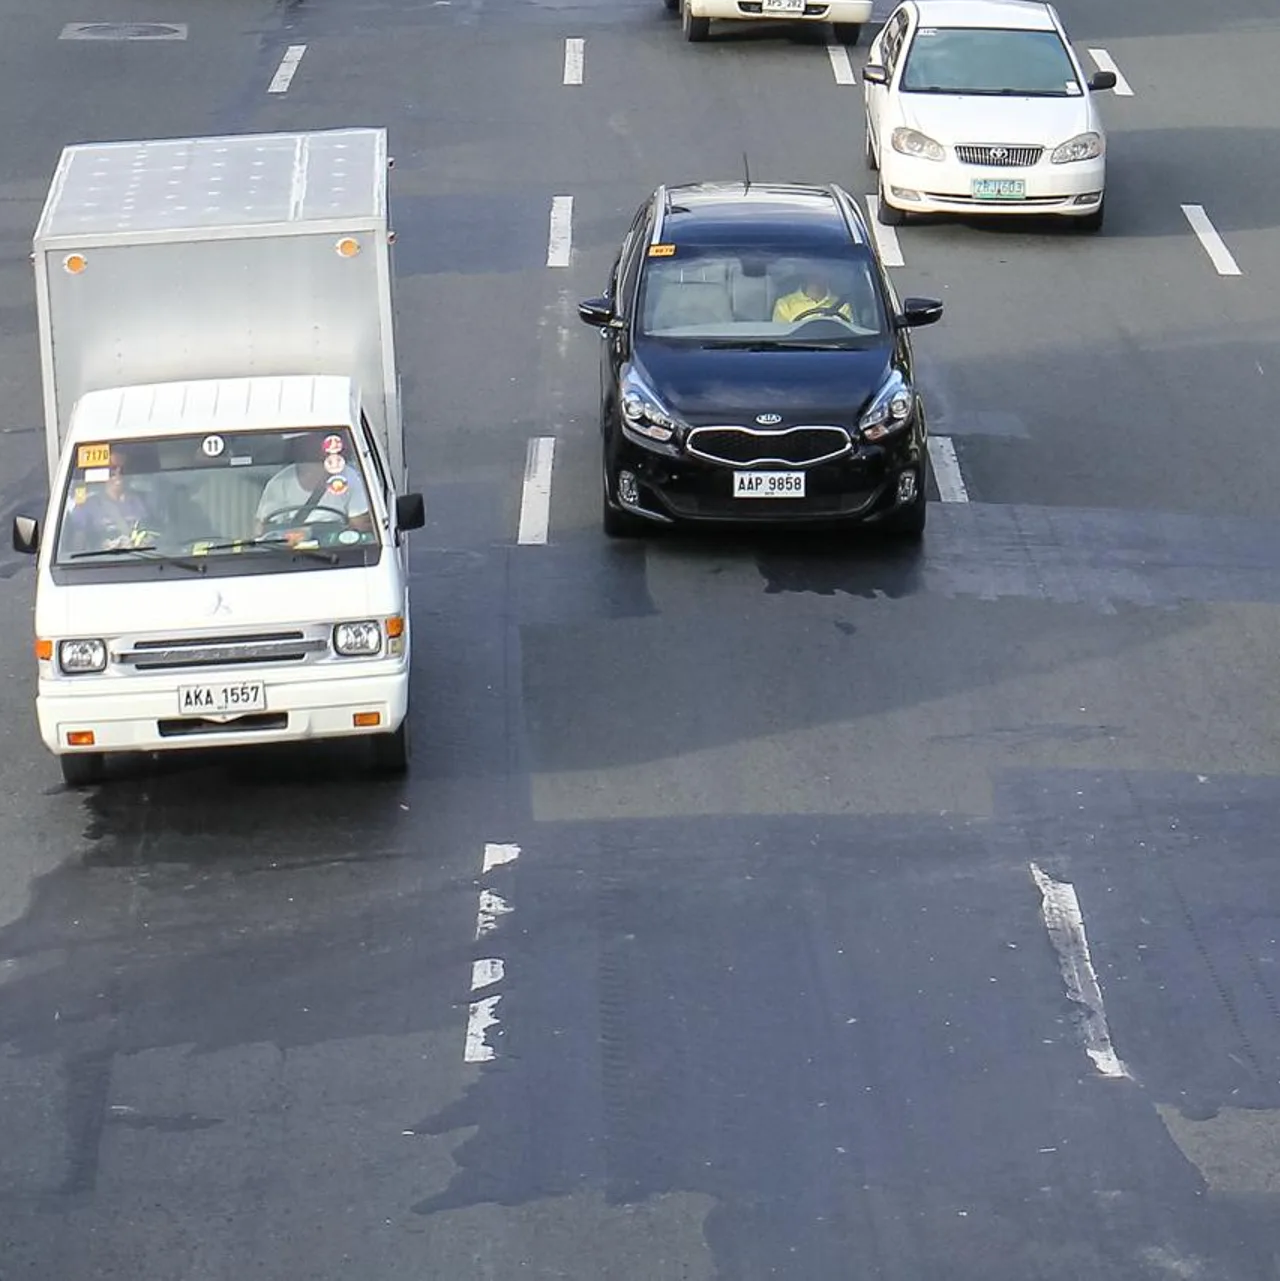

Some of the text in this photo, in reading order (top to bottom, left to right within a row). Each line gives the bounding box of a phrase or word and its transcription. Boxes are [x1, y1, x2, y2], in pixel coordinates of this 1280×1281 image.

[757, 414, 780, 423] KIA
[208, 441, 218, 451] 11
[738, 476, 802, 491] AAP 9858
[184, 684, 260, 707] AKA 1557
